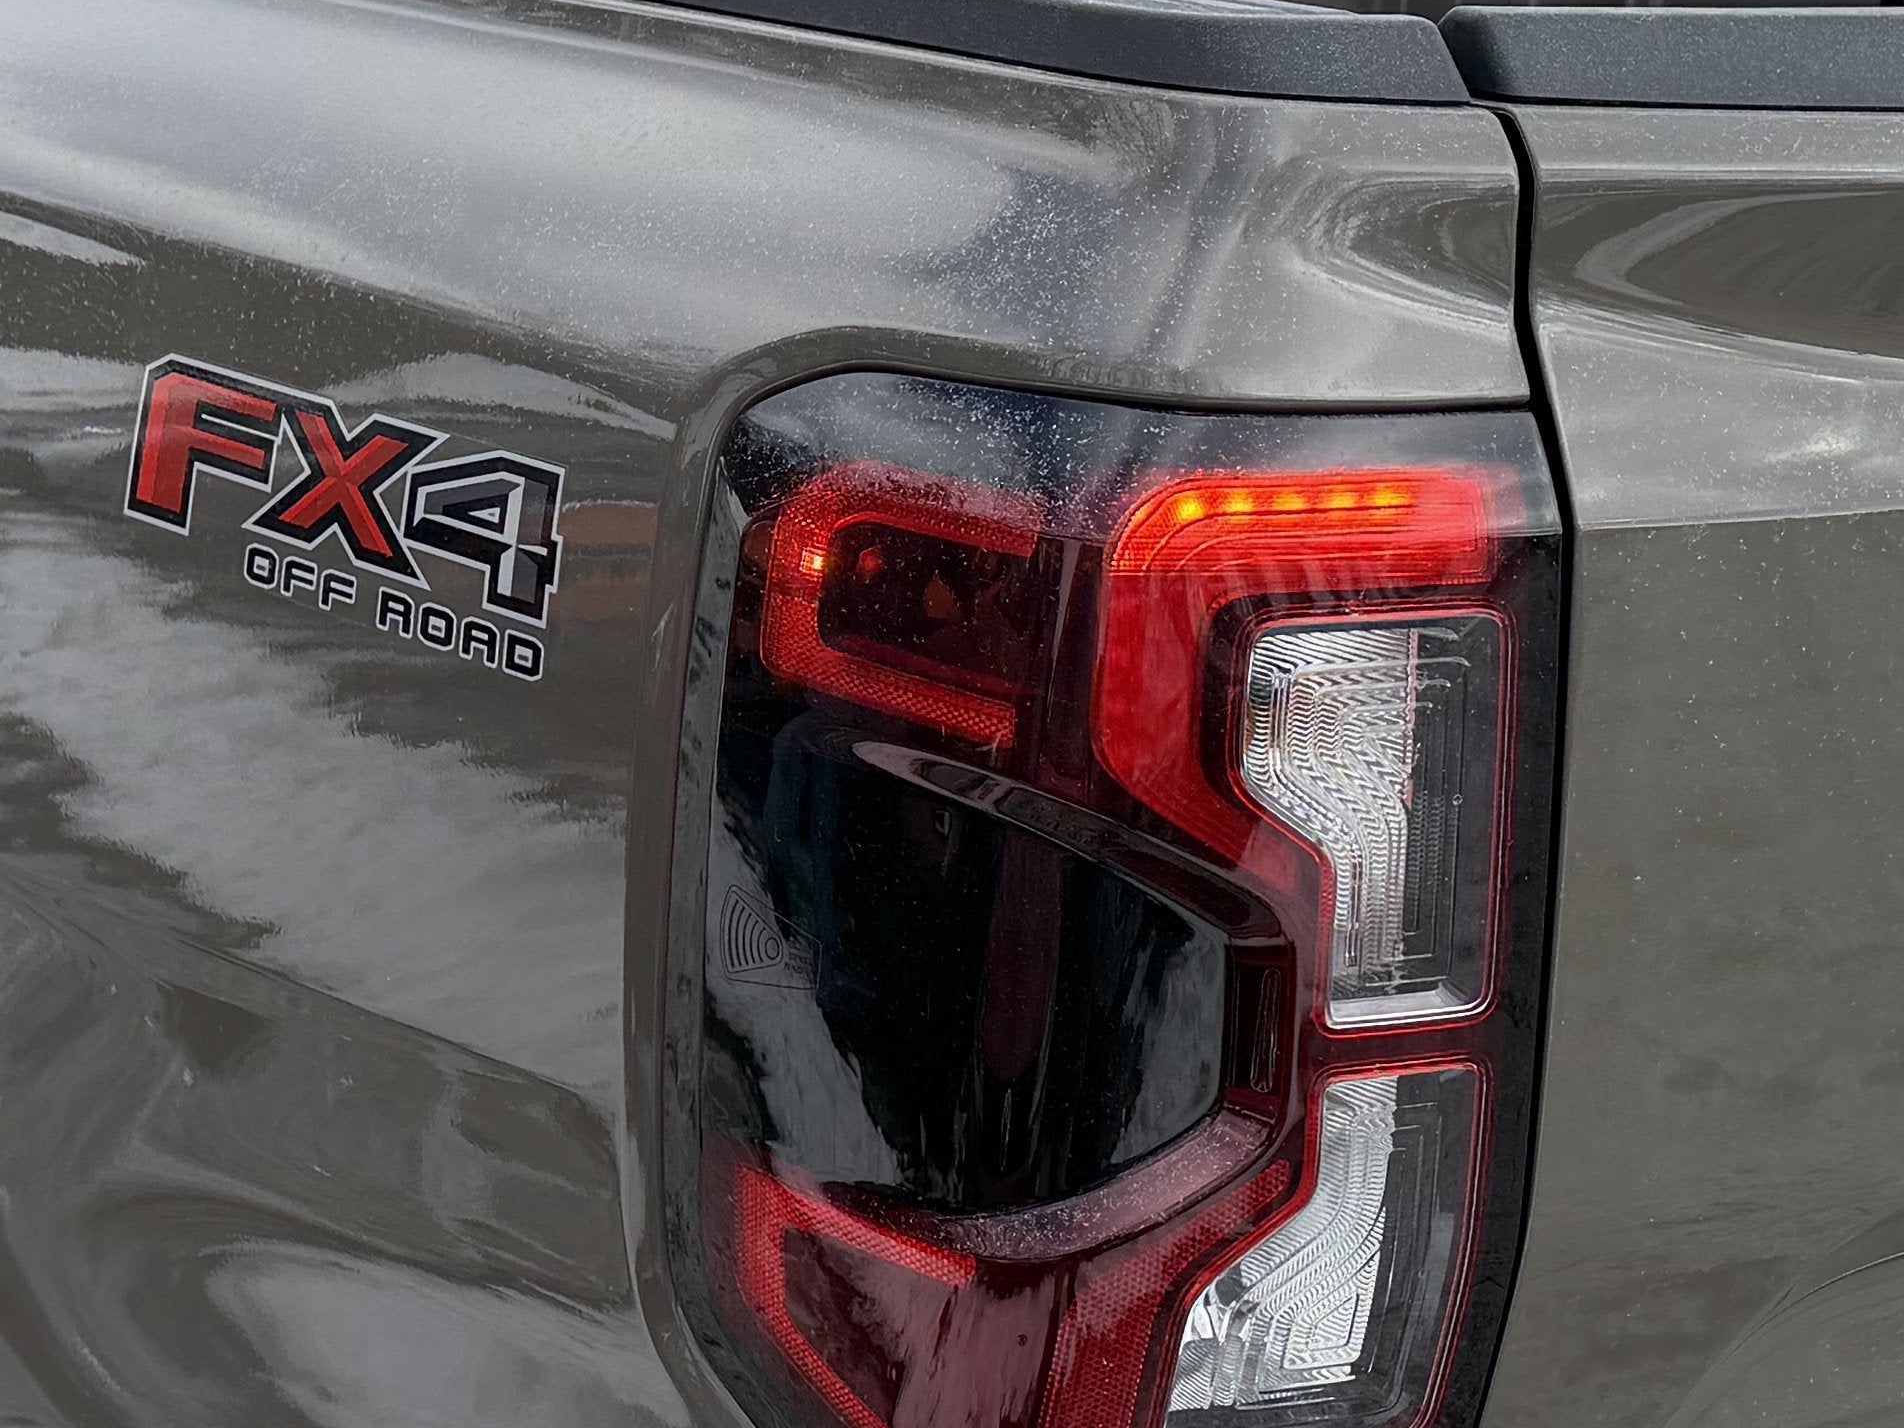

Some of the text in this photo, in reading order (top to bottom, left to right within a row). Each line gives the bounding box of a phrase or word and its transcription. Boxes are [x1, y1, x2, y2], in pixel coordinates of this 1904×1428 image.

[123, 353, 566, 628] FX4
[243, 543, 544, 681] OFF ROAD
